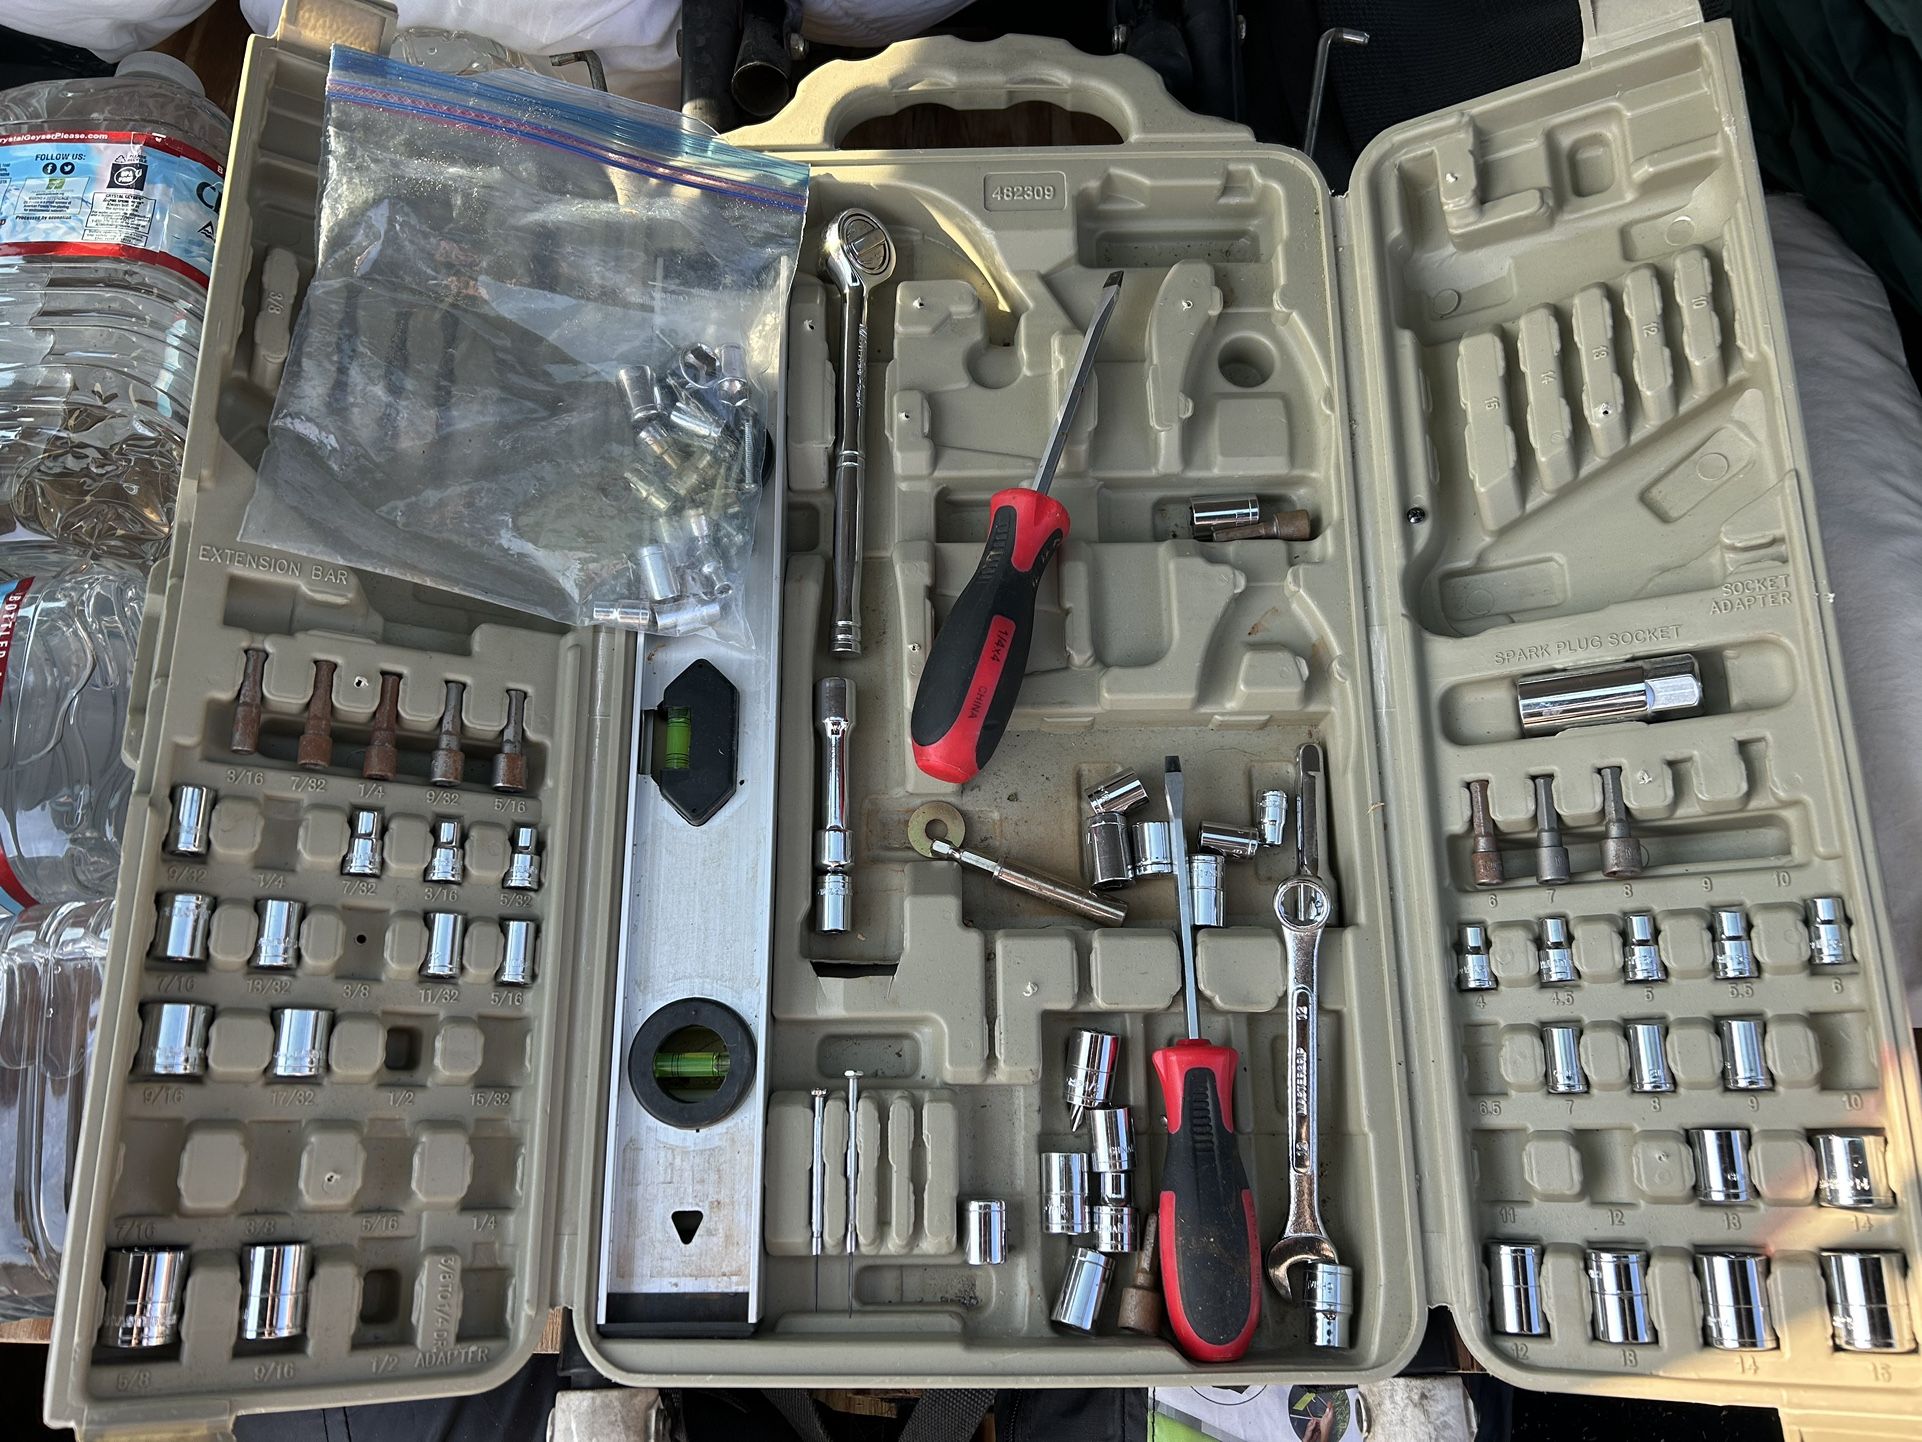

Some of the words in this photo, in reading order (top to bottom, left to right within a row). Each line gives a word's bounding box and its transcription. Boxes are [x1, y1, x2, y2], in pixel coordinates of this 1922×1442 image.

[0, 132, 108, 144] rystalGeyserPlease.com
[991, 184, 1055, 201] 482309
[267, 291, 284, 315] 3/8
[1692, 296, 1708, 309] 10
[1642, 322, 1659, 338] 12
[1592, 346, 1608, 360] 13
[1541, 370, 1556, 385] 14
[1484, 396, 1499, 410] 15
[199, 545, 300, 577] EXTENSION
[311, 565, 347, 584] BAR
[1722, 574, 1790, 596] SOCKET
[1710, 591, 1792, 615] ADAPTER
[990, 629, 1008, 662] 1/4x4
[1495, 644, 1551, 665] SPARK
[1555, 634, 1602, 657] PLUG
[1607, 624, 1681, 647] SOCKET
[968, 686, 988, 719] CHINA
[227, 769, 264, 785] 3/16
[291, 776, 327, 792] 7/32
[358, 783, 385, 798] 1/4
[426, 790, 459, 806] 9/32
[494, 798, 526, 813] 5/16
[167, 866, 207, 882] 9/32
[258, 873, 285, 889] 1/4
[1774, 871, 1792, 887] 10
[343, 881, 377, 896] 7/32
[1623, 883, 1633, 898] 8
[1703, 876, 1713, 891] 9
[425, 888, 457, 902] 3/16
[500, 893, 531, 908] 5/32
[1488, 894, 1498, 908] 6
[1547, 888, 1557, 903] 7
[156, 975, 195, 991] 7/16
[247, 979, 291, 995] 13/32
[1728, 983, 1754, 998] 5.5
[1831, 978, 1843, 994] 6
[344, 984, 370, 999] 3/8
[419, 988, 459, 1004] 11/32
[491, 991, 523, 1006] 5/16
[1552, 991, 1574, 1006] 4.5
[1644, 986, 1654, 1001] 5
[1476, 995, 1486, 1009] 4
[1296, 1006, 1308, 1021] 12
[143, 1086, 184, 1104] 9/16
[271, 1089, 315, 1106] 17/32
[388, 1091, 415, 1106] 1/2
[470, 1092, 510, 1106] 15/32
[1842, 1094, 1862, 1110] 10
[1480, 1102, 1501, 1117] 6.5
[1565, 1101, 1574, 1115] 7
[1651, 1098, 1660, 1112] 8
[1748, 1096, 1759, 1111] 9
[472, 1215, 497, 1231] 1/4
[1500, 1208, 1516, 1223] 11
[1608, 1209, 1625, 1226] 12
[1724, 1213, 1742, 1230] 13
[1851, 1214, 1873, 1231] 14
[115, 1222, 156, 1239] 7/16
[246, 1219, 276, 1235] 3/8
[361, 1216, 399, 1233] 5/16
[415, 1345, 488, 1368] ADAPTER
[1511, 1343, 1529, 1360] 12
[1621, 1349, 1638, 1367] 13
[253, 1362, 295, 1382] 9/16
[370, 1356, 398, 1373] 1/2
[1740, 1357, 1759, 1374] 14
[1873, 1363, 1892, 1382] 15
[116, 1372, 151, 1392] 5/8
